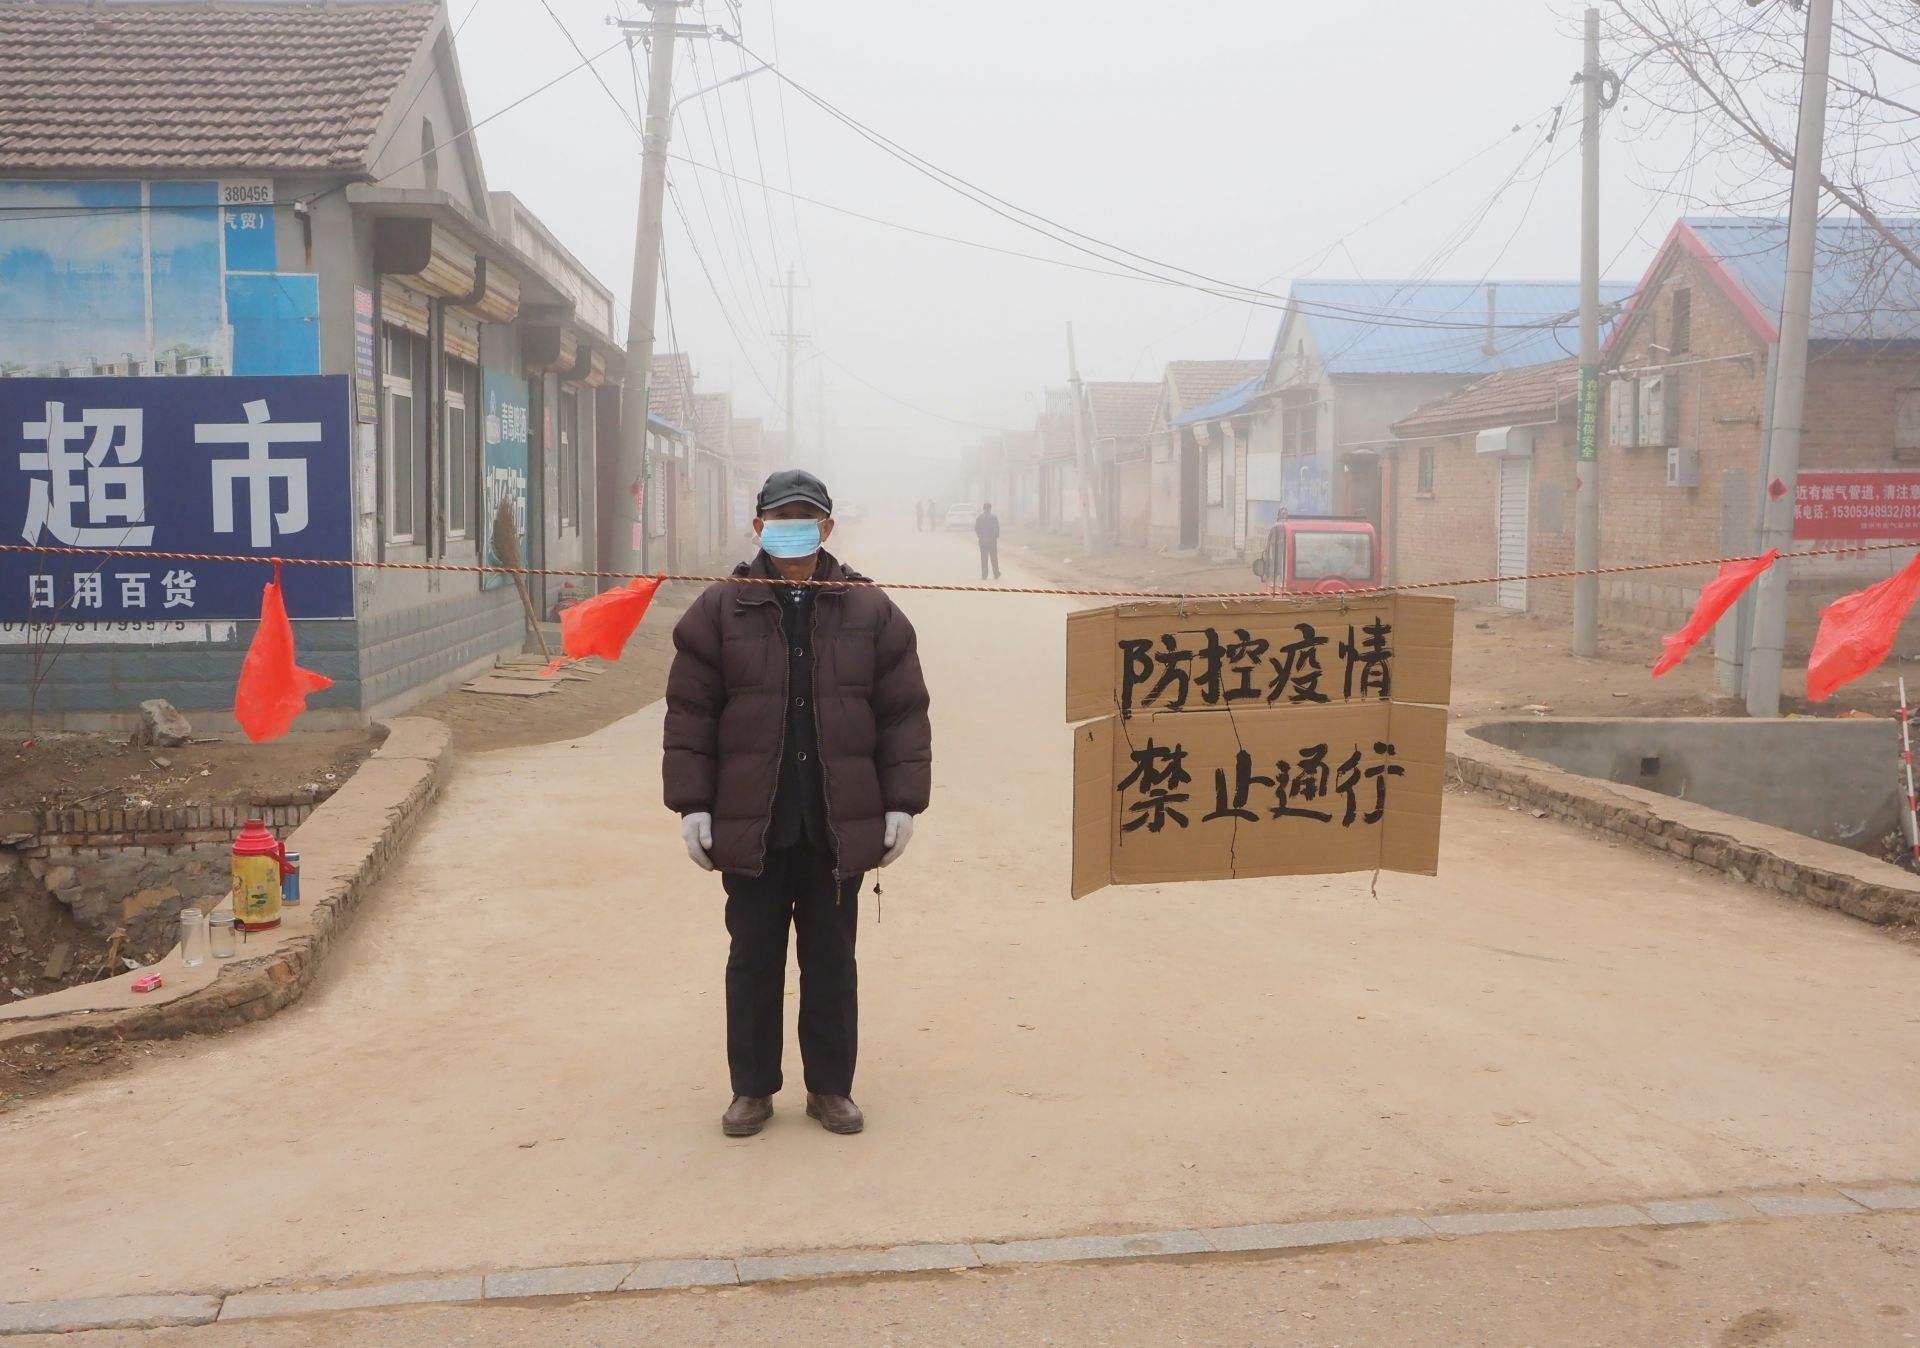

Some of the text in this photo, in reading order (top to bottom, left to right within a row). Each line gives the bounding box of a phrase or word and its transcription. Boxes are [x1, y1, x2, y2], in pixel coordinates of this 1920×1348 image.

[224, 185, 269, 202] 380456
[20, 398, 322, 549] 超市
[28, 569, 198, 610] 日用百货
[1117, 616, 1395, 721] 防控疫情
[1116, 737, 1406, 833] 禁止通行
